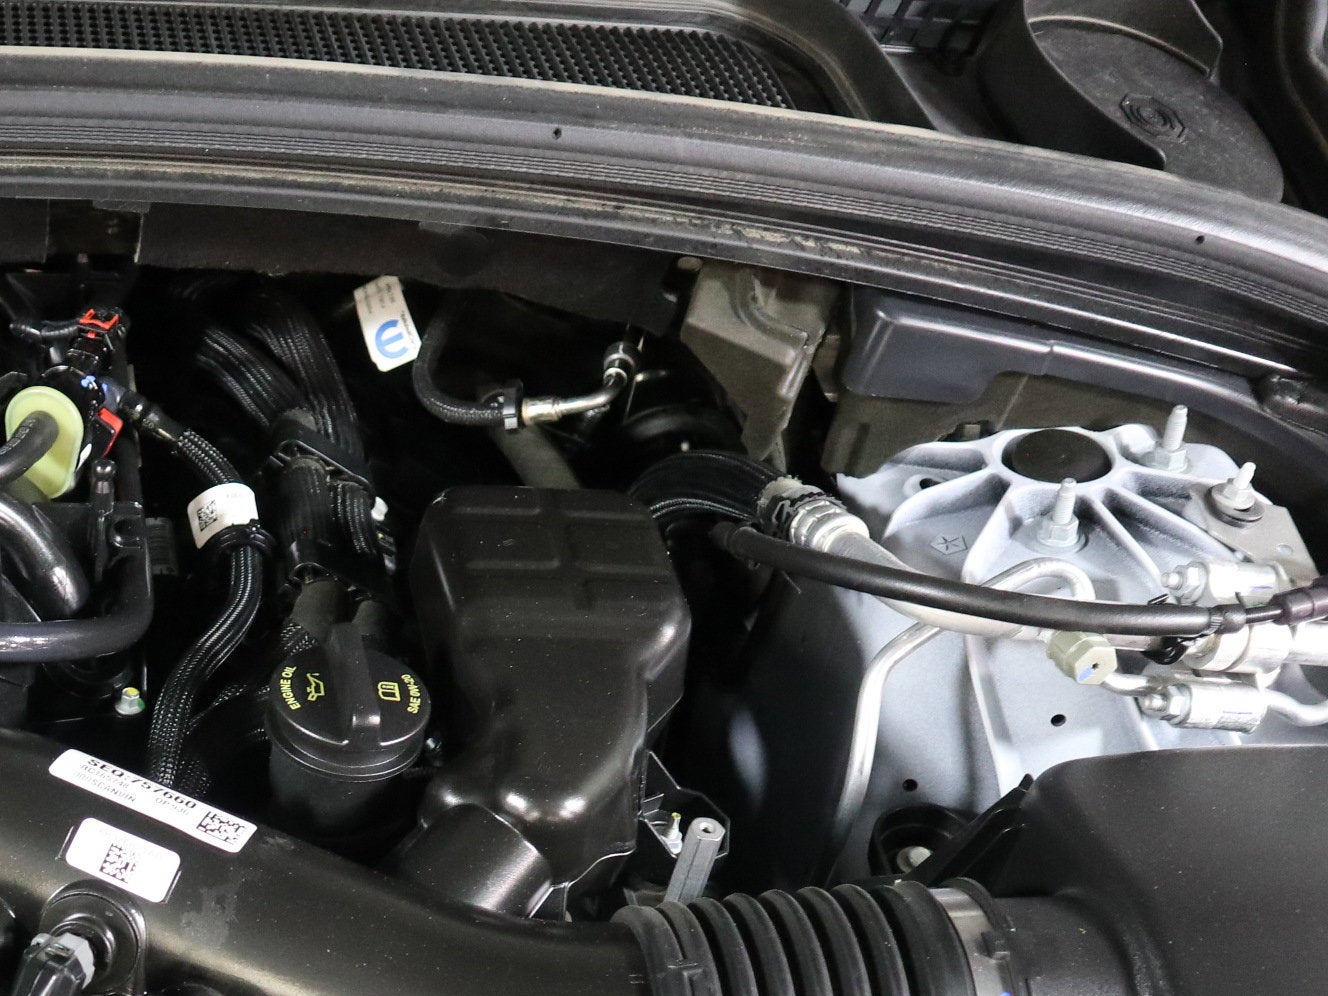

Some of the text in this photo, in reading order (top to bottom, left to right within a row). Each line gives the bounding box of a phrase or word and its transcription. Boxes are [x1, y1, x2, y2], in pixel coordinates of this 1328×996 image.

[280, 666, 301, 710] ENGINE OIL
[401, 674, 421, 714] SAE 0W-20
